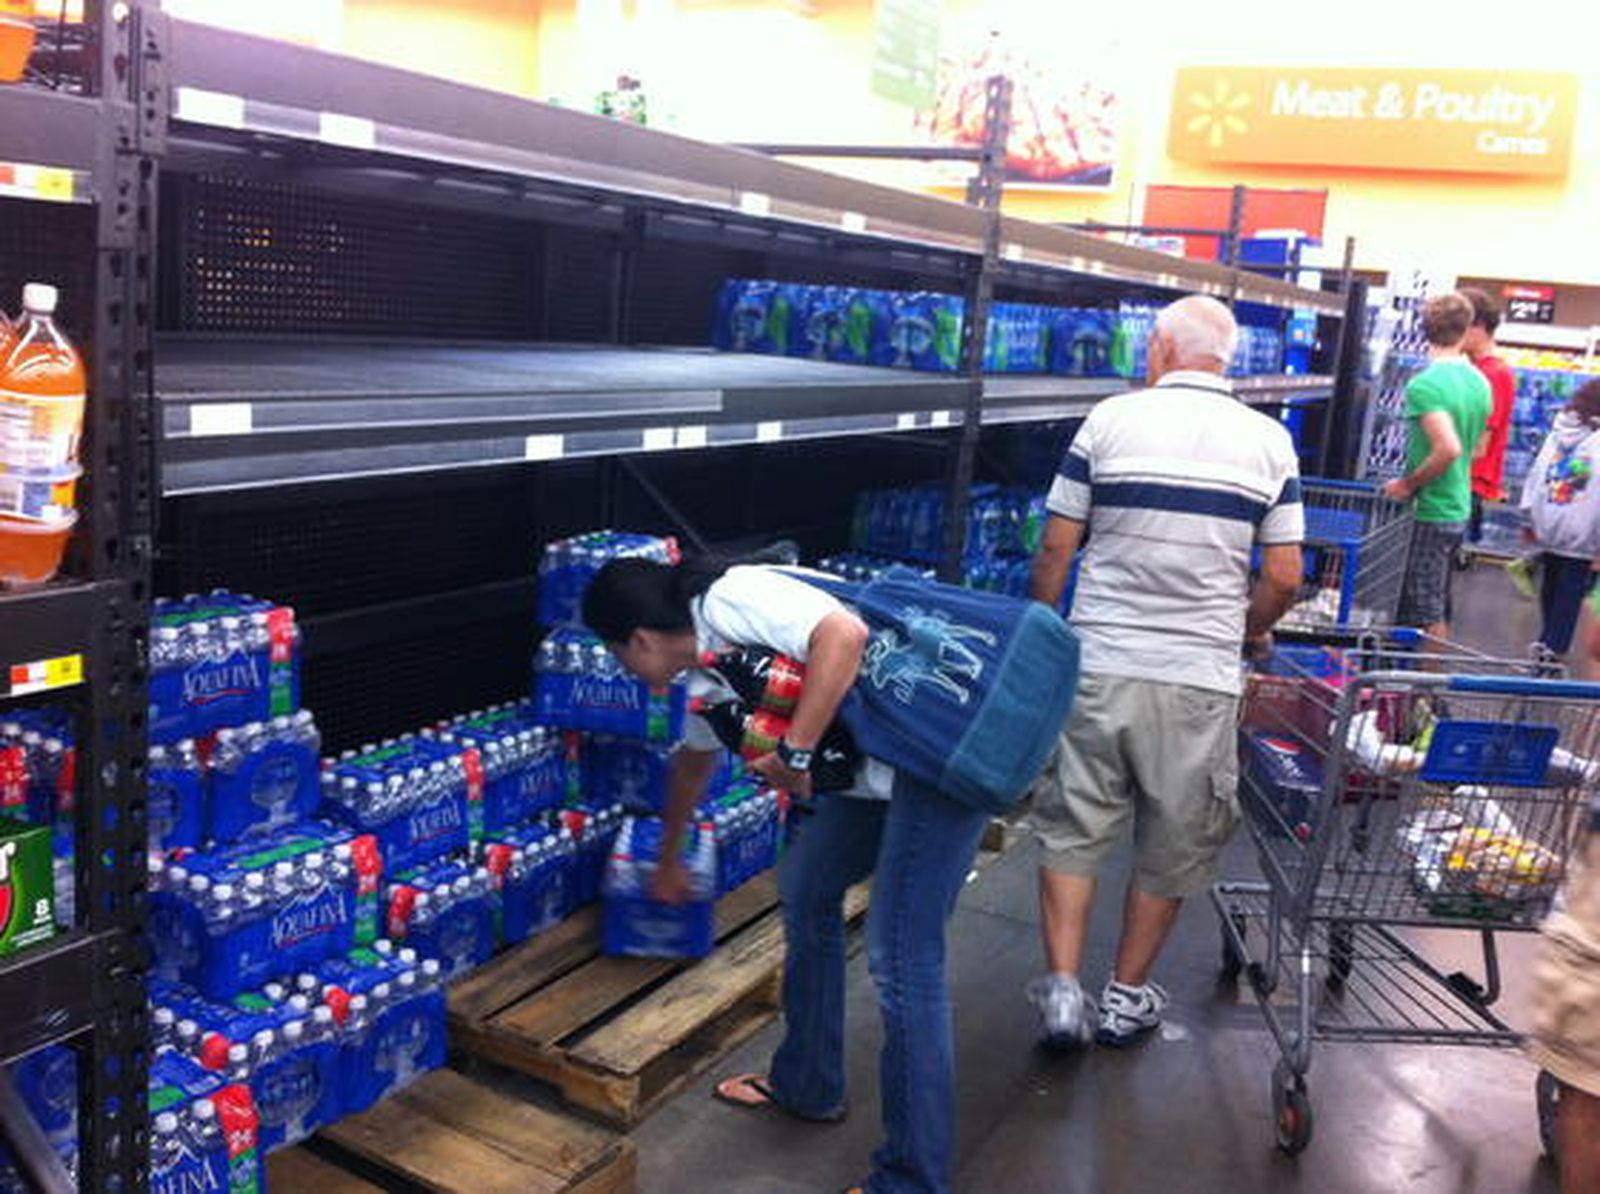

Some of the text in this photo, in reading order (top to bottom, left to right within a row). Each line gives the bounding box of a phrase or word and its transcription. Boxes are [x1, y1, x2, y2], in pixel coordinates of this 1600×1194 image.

[1272, 79, 1556, 134] Meat & Poultry
[35, 898, 50, 916] 8
